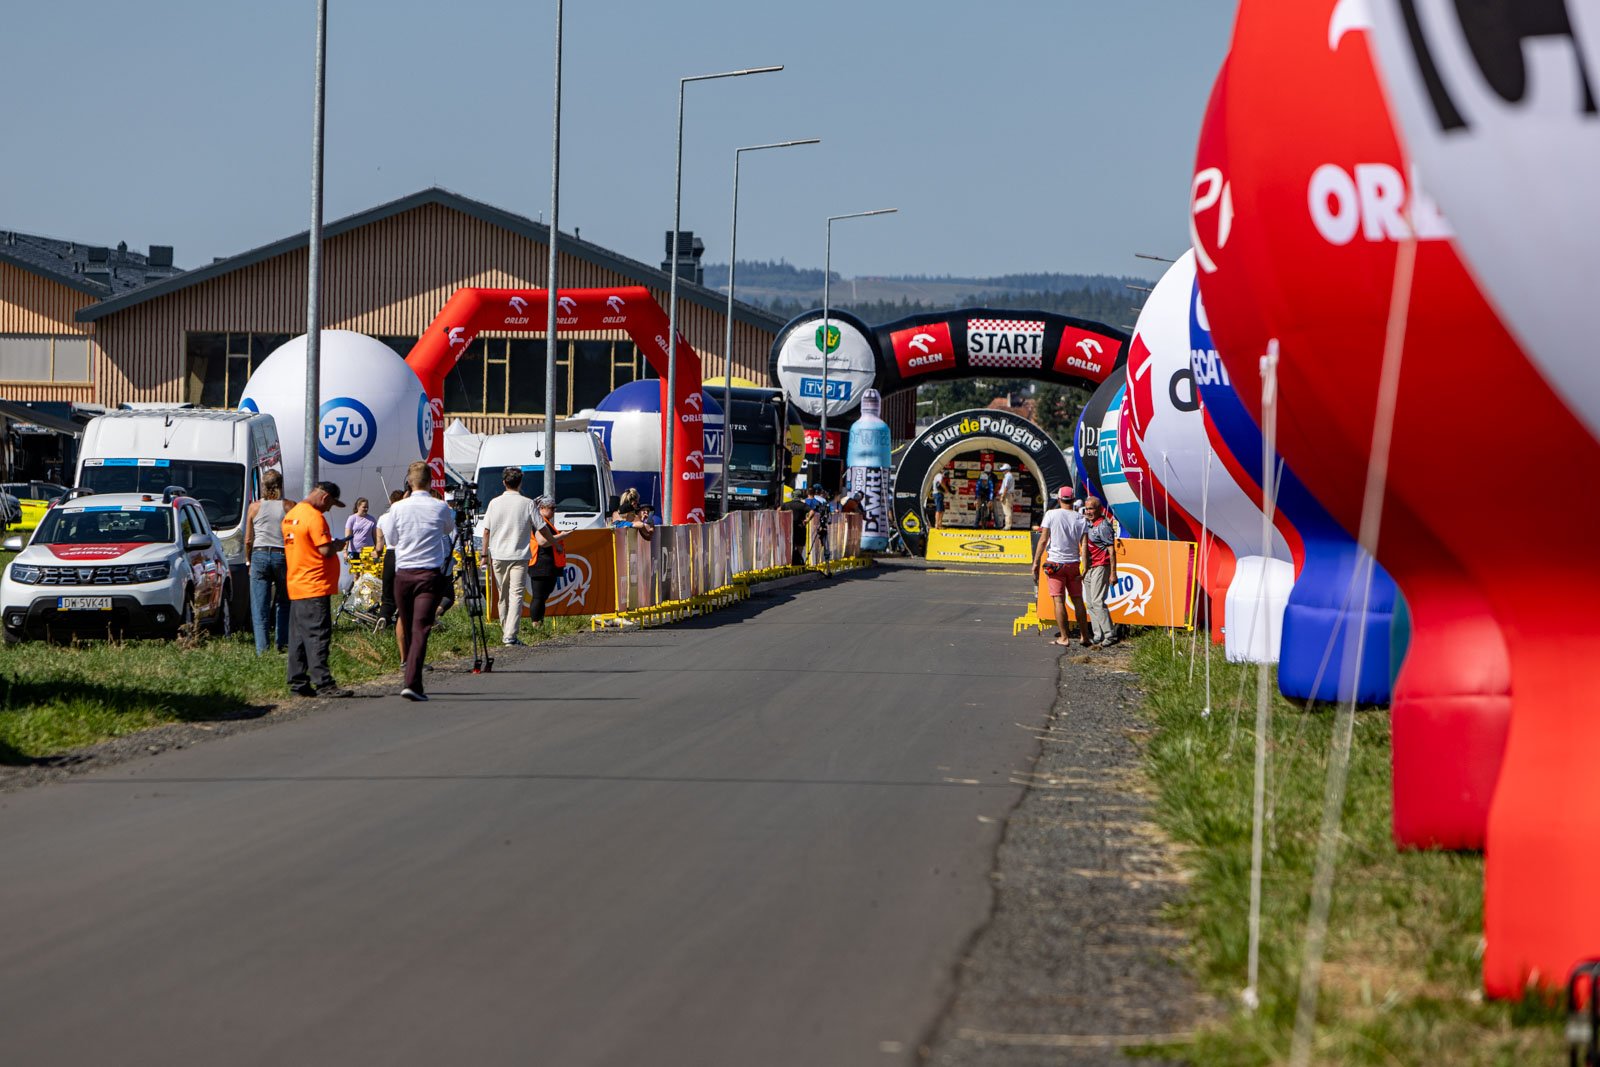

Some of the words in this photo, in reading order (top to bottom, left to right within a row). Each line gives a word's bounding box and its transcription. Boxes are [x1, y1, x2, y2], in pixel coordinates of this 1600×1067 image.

[603, 316, 626, 324] ORLEN
[970, 332, 1042, 355] START
[908, 353, 943, 368] ORLEN
[1067, 356, 1101, 373] ORLEN
[838, 384, 846, 398] 1
[324, 416, 363, 446] PZU
[64, 598, 76, 608] DW
